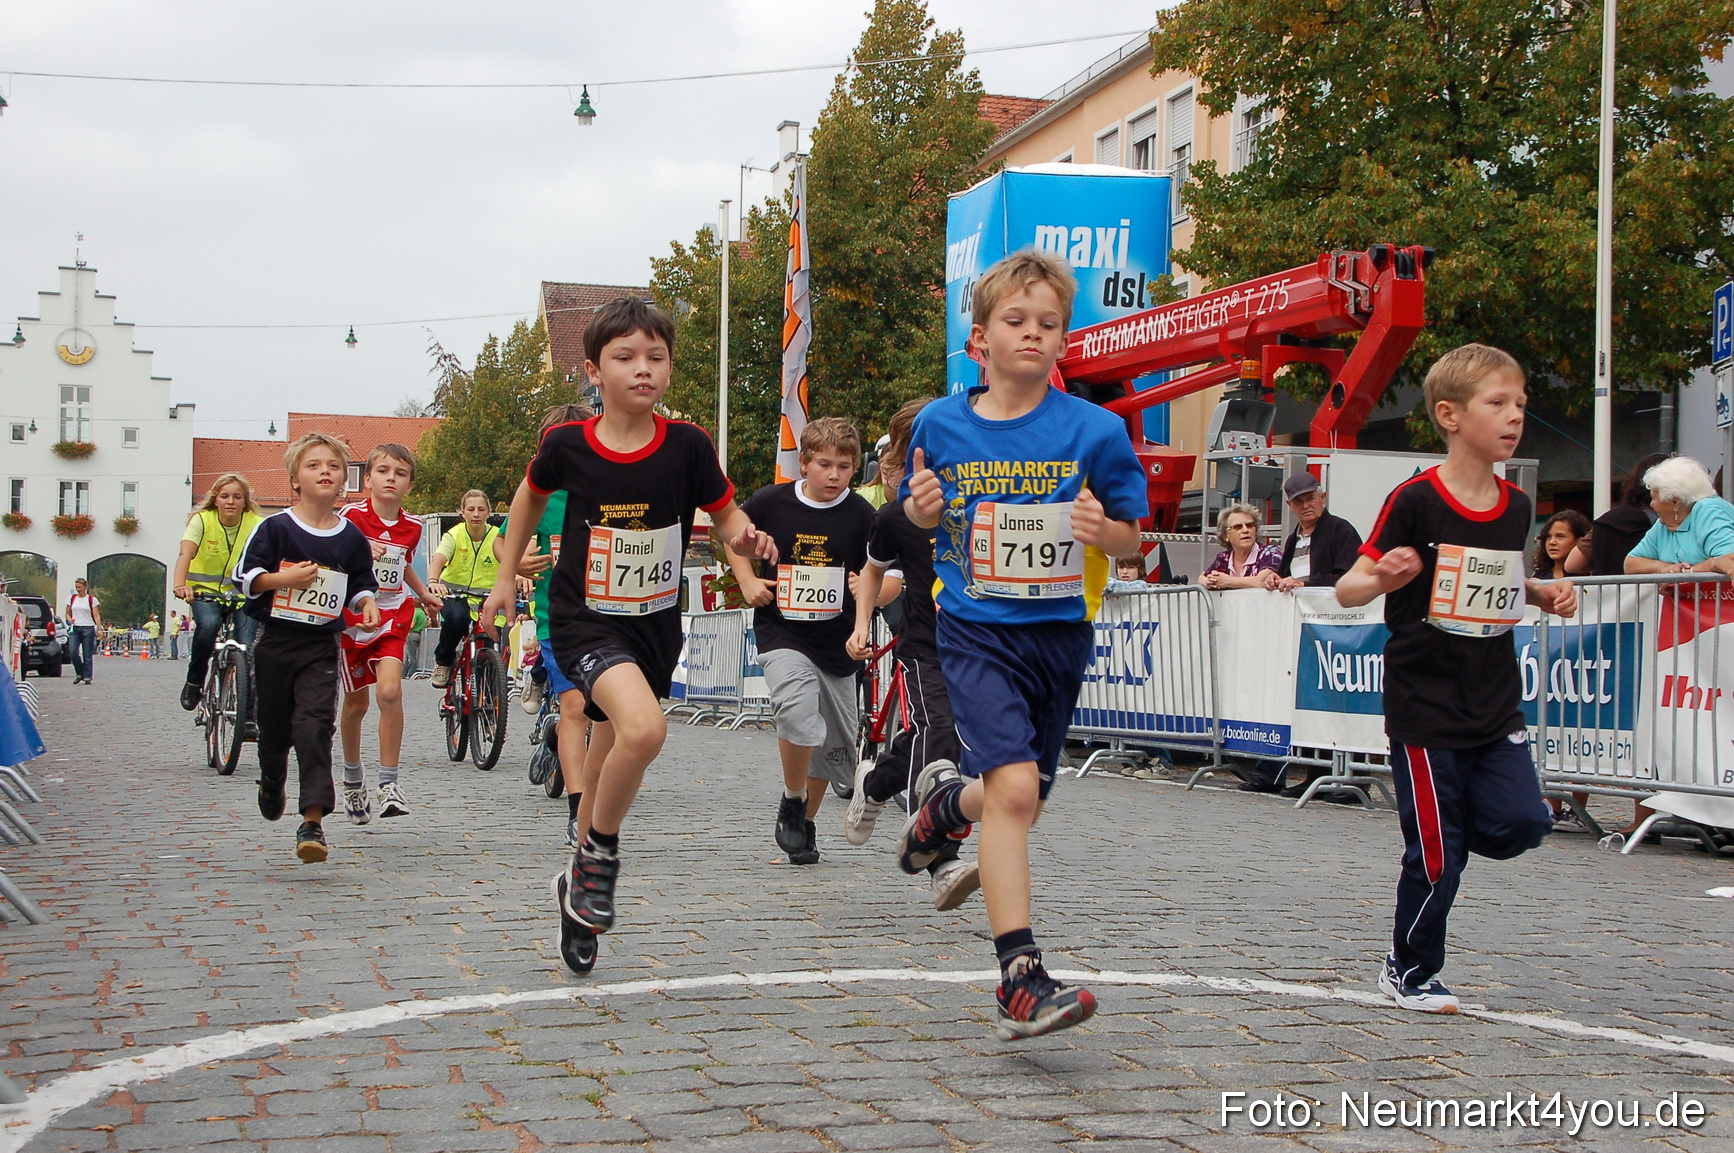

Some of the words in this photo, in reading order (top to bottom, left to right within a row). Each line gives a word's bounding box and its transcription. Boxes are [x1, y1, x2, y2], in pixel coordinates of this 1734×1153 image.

[946, 222, 983, 284] maxi
[1034, 218, 1131, 270] maxi
[1103, 270, 1146, 309] dsl
[1243, 288, 1255, 319] T
[1256, 278, 1291, 316] 275
[1717, 297, 1728, 353] P
[956, 460, 1080, 480] NEUMARKTER
[957, 478, 1058, 497] STADTLAUF
[600, 503, 650, 512] NEUMARKTER
[603, 510, 646, 519] STADTLAUF
[999, 512, 1044, 531] Jonas
[614, 537, 654, 556] Daniel
[974, 538, 987, 552] K6
[1001, 540, 1075, 568] 7197
[590, 560, 602, 573] K6
[615, 560, 673, 588] 7148
[795, 570, 811, 582] Tim
[1467, 556, 1507, 576] Daniel
[779, 585, 788, 594] K6
[795, 587, 838, 604] 7206
[1041, 580, 1083, 592] PFLEIDERER
[1438, 579, 1453, 592] K6
[297, 588, 338, 609] 7208
[1466, 583, 1521, 611] 7187
[1660, 674, 1722, 712] Ihr
[1609, 736, 1632, 760] ich
